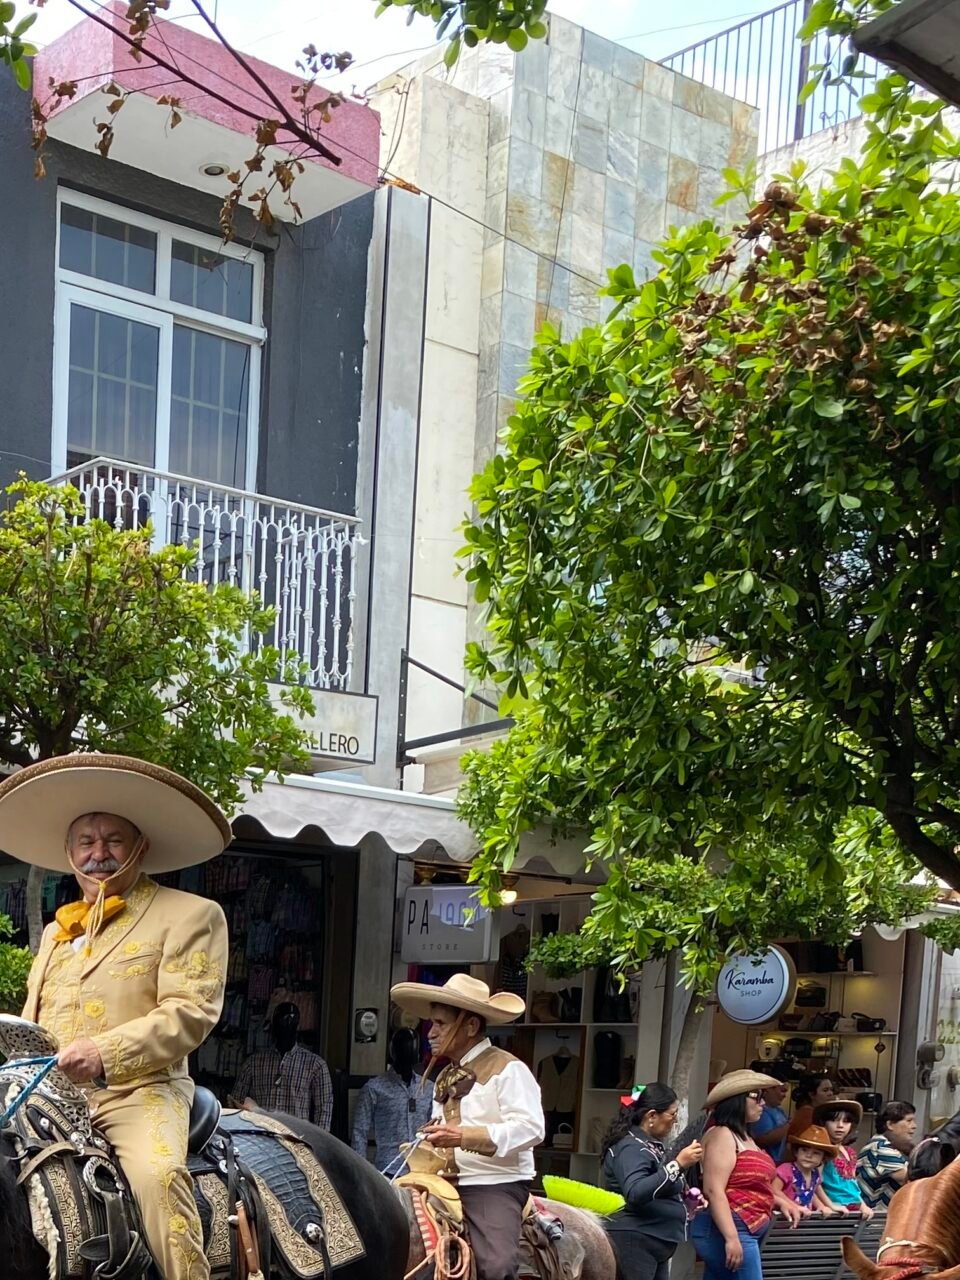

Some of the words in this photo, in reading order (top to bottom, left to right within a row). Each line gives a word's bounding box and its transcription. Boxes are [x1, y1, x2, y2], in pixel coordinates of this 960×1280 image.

[421, 943, 459, 951] STORE
[725, 968, 774, 991] Karamba
[741, 990, 763, 998] SHOP
